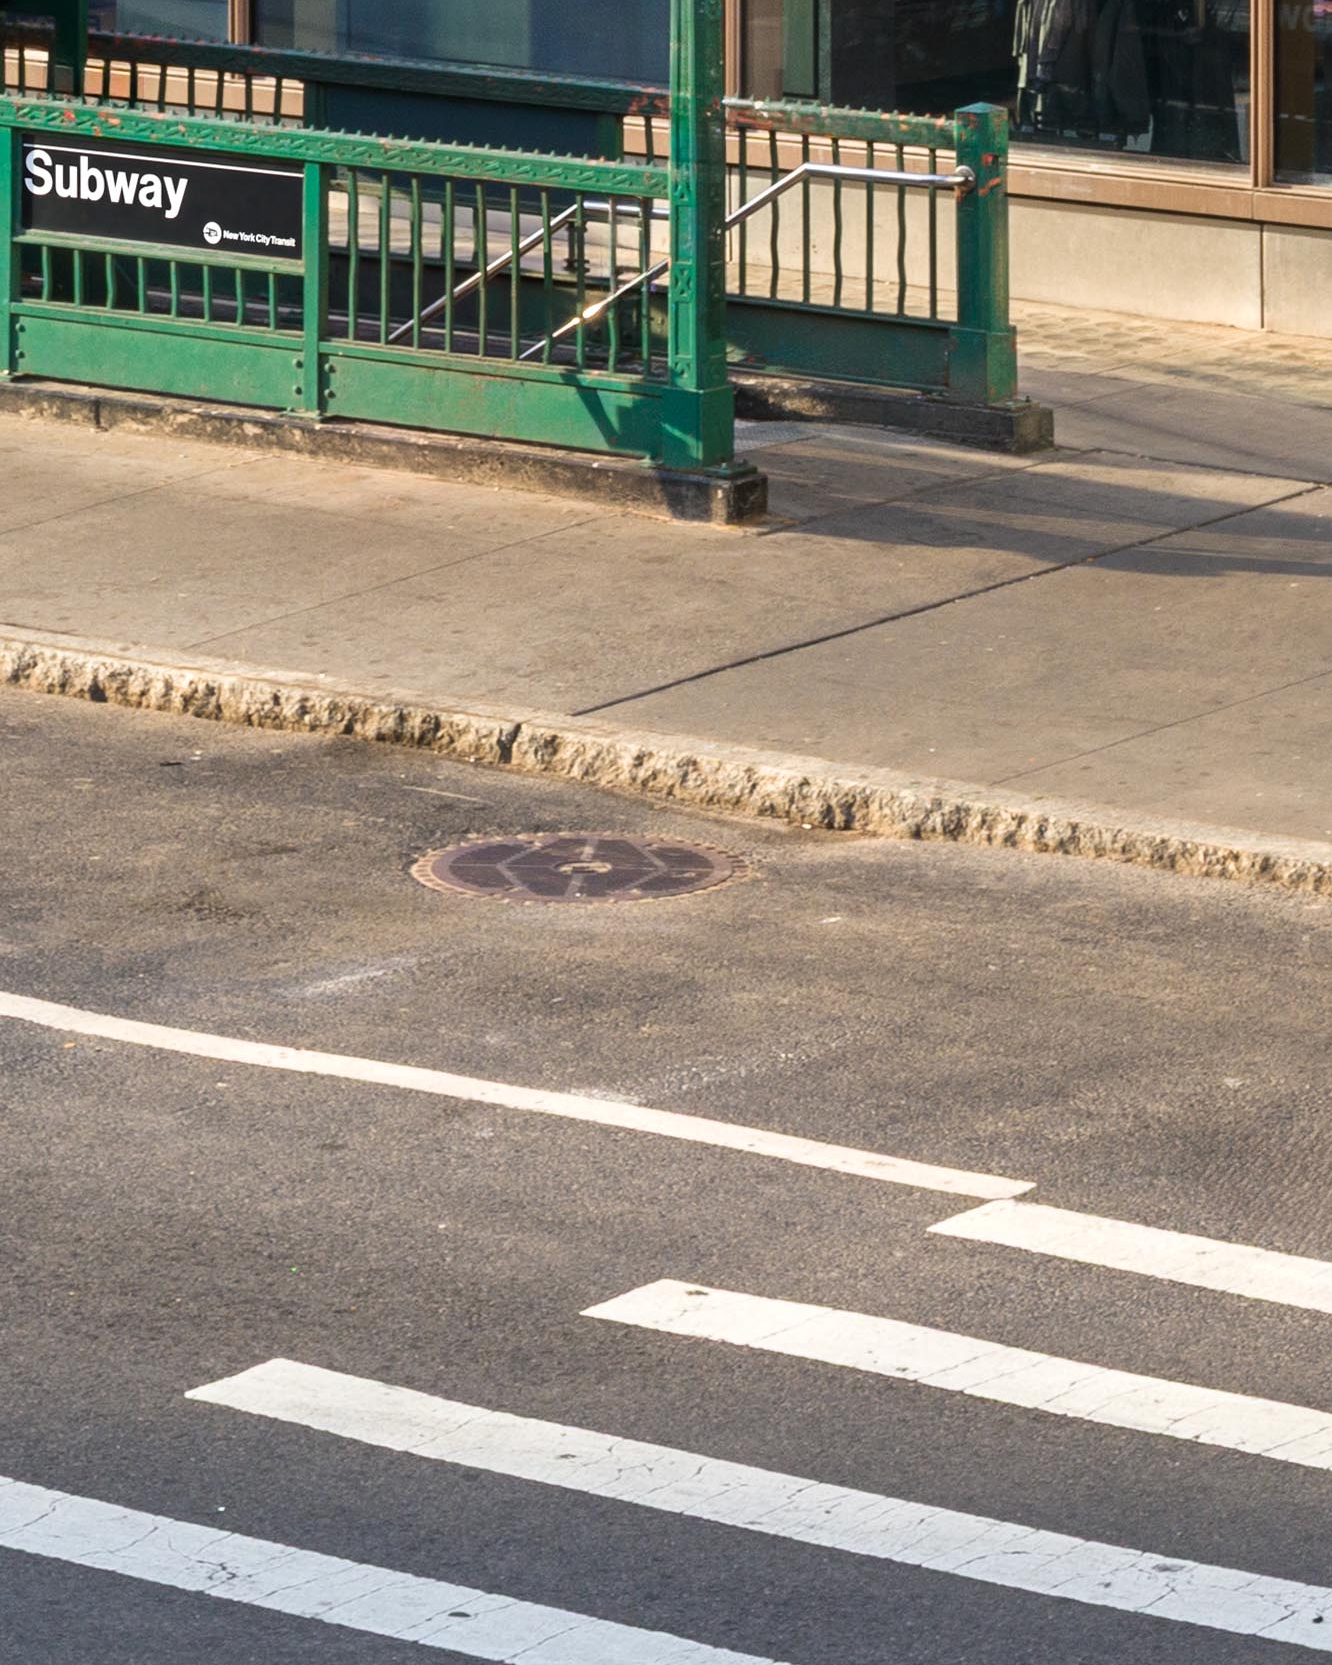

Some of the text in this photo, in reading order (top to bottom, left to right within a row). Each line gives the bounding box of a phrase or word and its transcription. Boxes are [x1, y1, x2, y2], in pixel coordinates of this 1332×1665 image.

[24, 149, 188, 219] Subway
[223, 230, 239, 241] New
[239, 232, 256, 243] York
[256, 233, 271, 246] City
[270, 235, 296, 247] Transit
